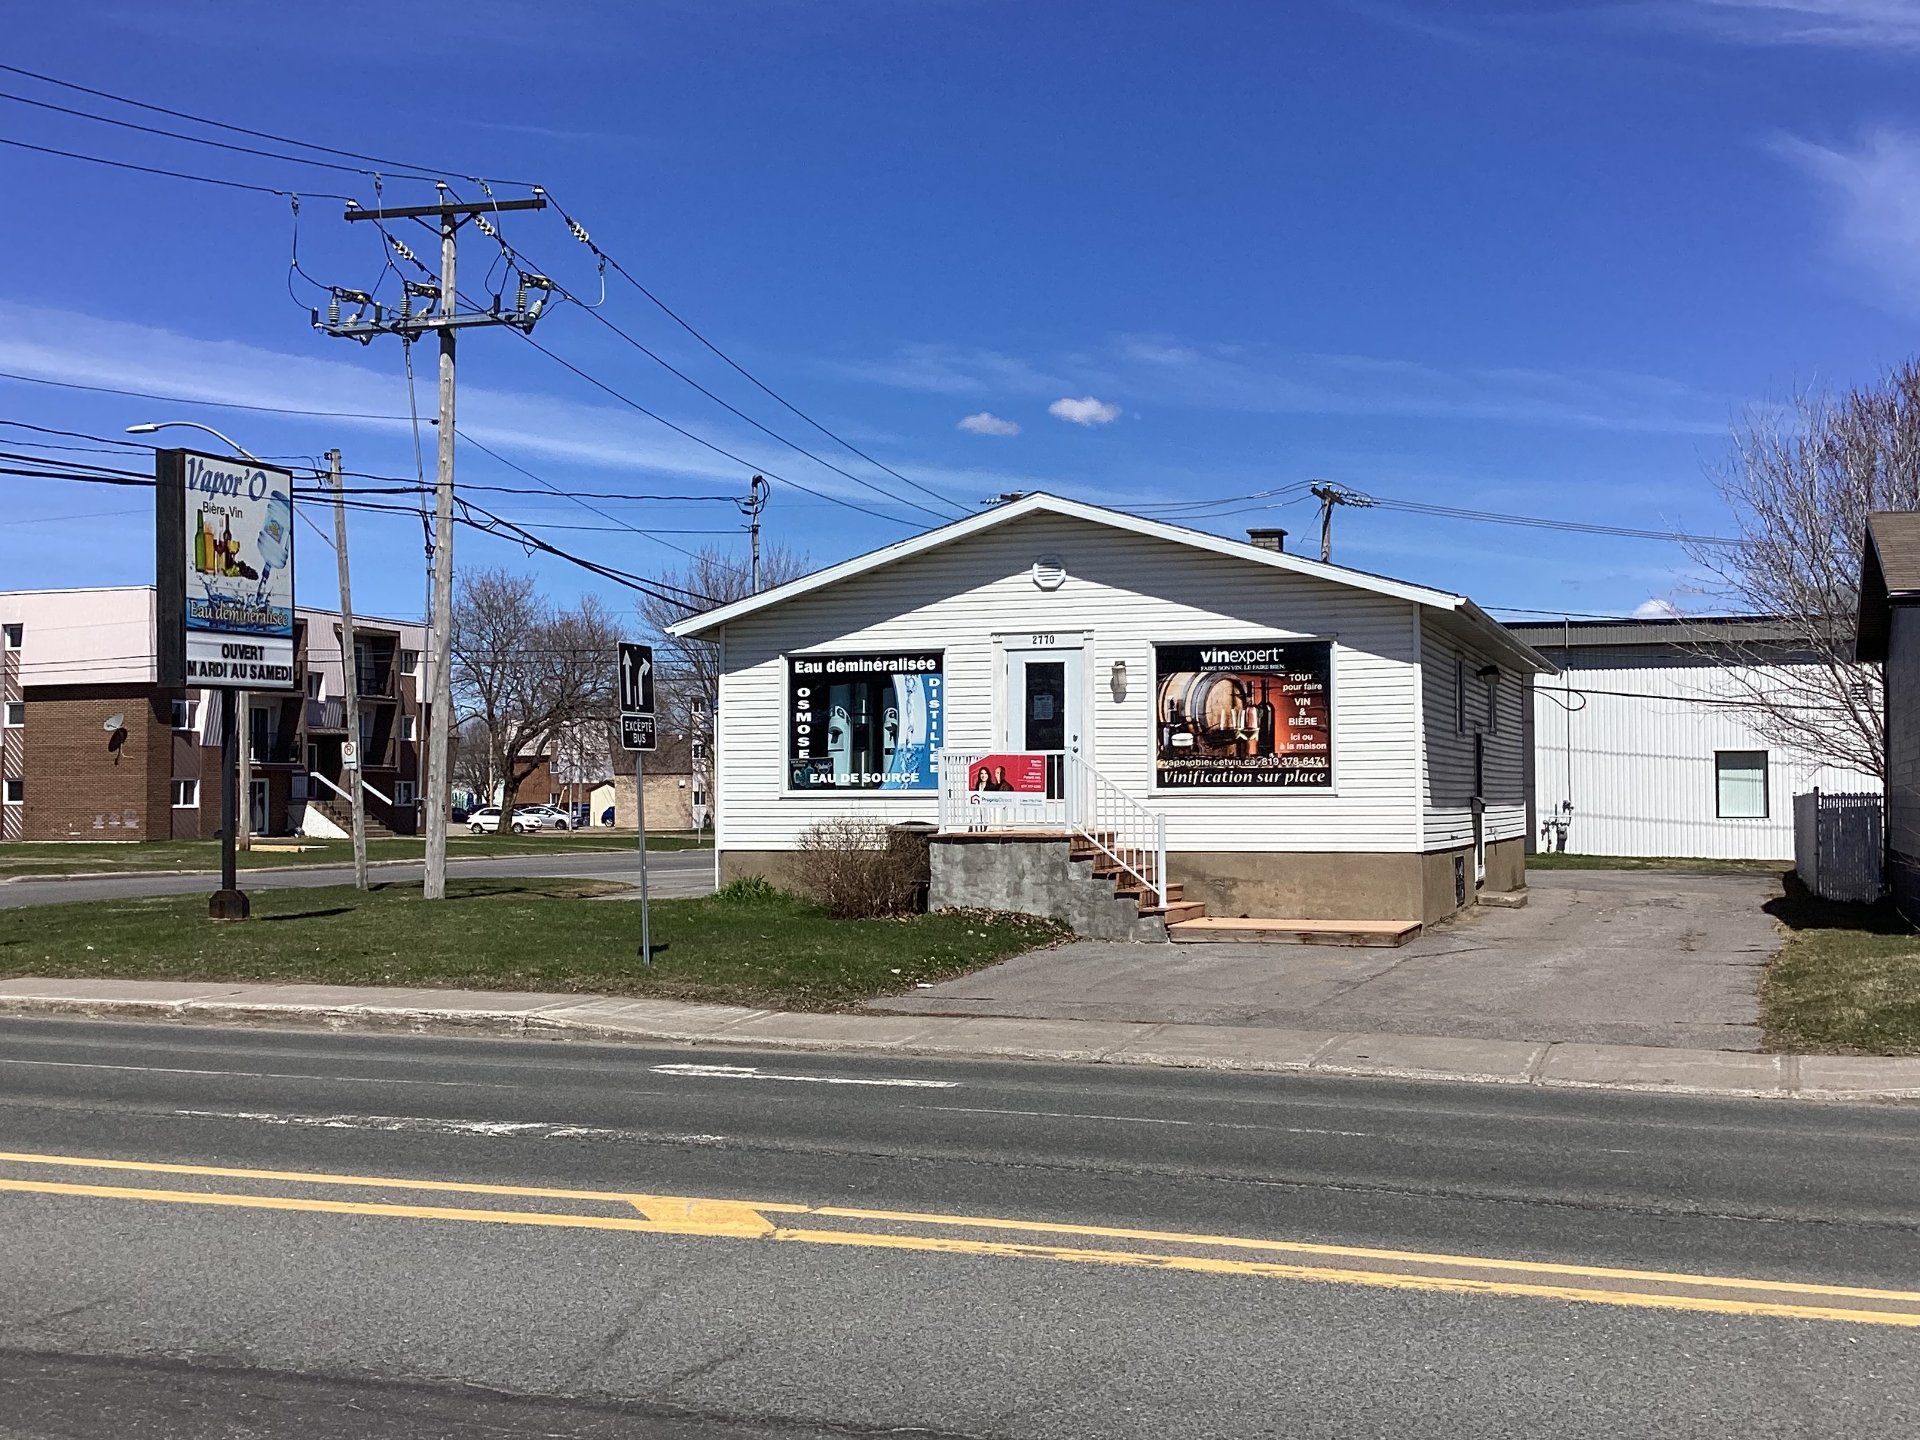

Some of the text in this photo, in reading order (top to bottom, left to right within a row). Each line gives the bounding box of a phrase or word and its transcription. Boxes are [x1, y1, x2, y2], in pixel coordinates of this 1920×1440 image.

[187, 457, 267, 501] Vapor'O
[202, 501, 243, 518] Bière Vin
[189, 599, 213, 619] Eau
[1032, 635, 1055, 645] 2770
[221, 643, 264, 661] OUVERT
[1200, 647, 1280, 665] vinexpert
[794, 656, 936, 674] Eau déminéralisée
[230, 663, 247, 679] AU
[249, 664, 293, 682] SAMEDI
[1282, 682, 1323, 692] pour faire
[1294, 697, 1311, 706] VIN
[1299, 707, 1306, 716] &
[796, 687, 812, 759] OSMOSE
[1288, 716, 1318, 726] BIÈRE
[633, 732, 646, 743] BUS
[1279, 742, 1327, 750] à la maison
[1261, 757, 1280, 766] 819
[1281, 756, 1326, 766] 378-6471
[809, 773, 920, 784] EAU DE SOURCE
[1164, 769, 1326, 785] Vinification sur place
